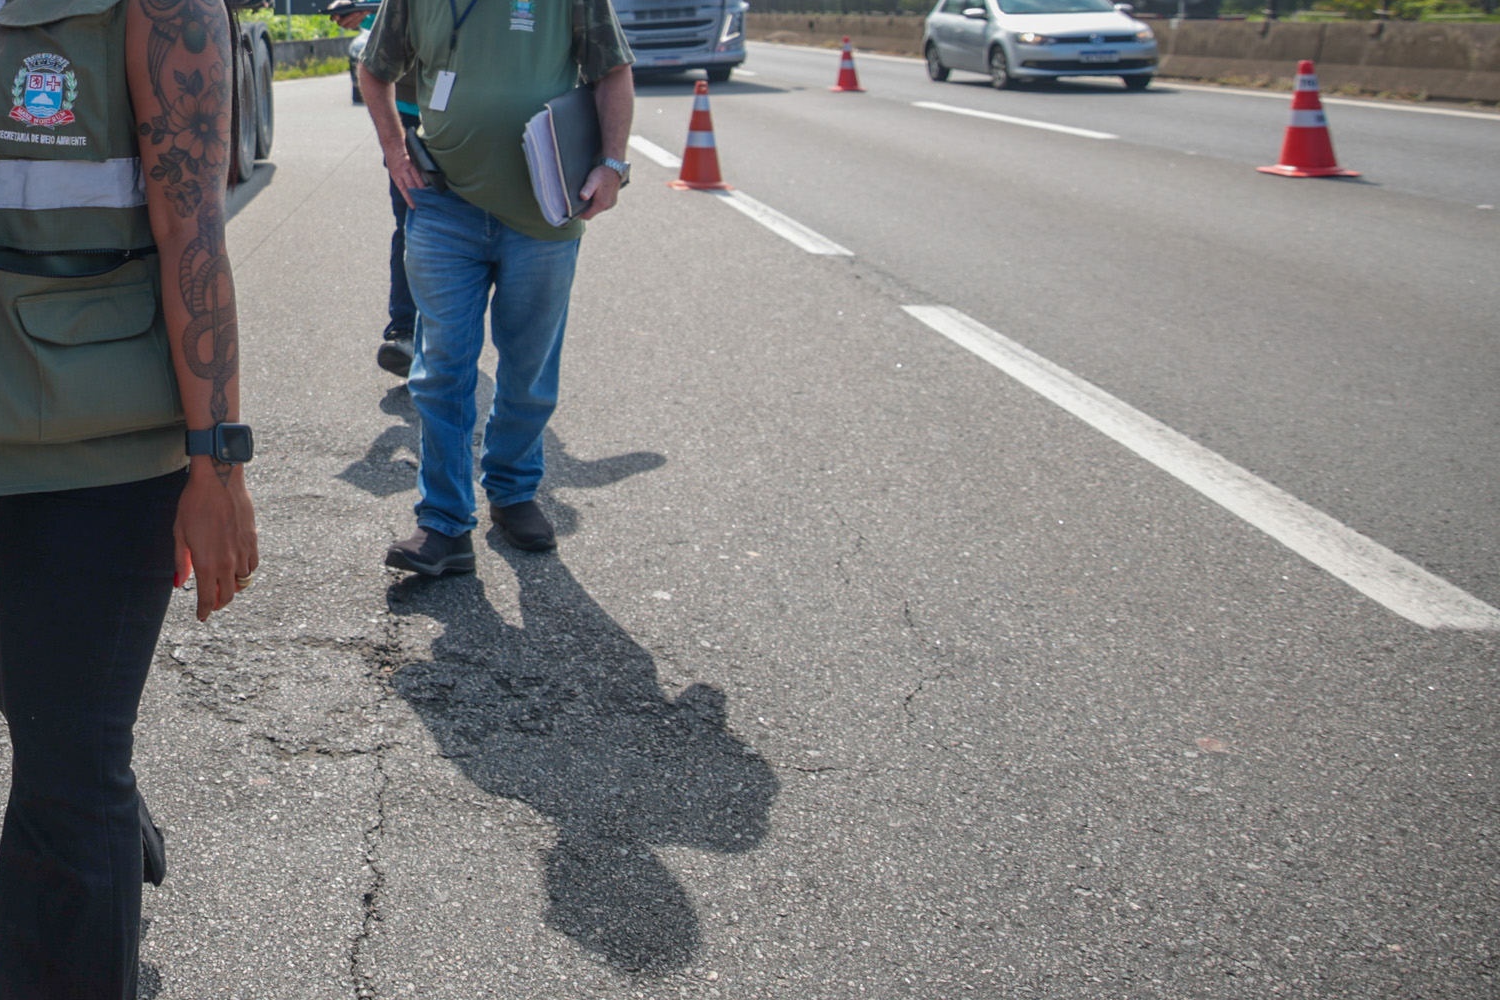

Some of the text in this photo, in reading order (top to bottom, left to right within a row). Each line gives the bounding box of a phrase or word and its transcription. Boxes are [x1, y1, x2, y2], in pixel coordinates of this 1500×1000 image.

[31, 134, 39, 143] DE
[41, 135, 55, 145] MEIO
[57, 136, 86, 146] AMBIENTE
